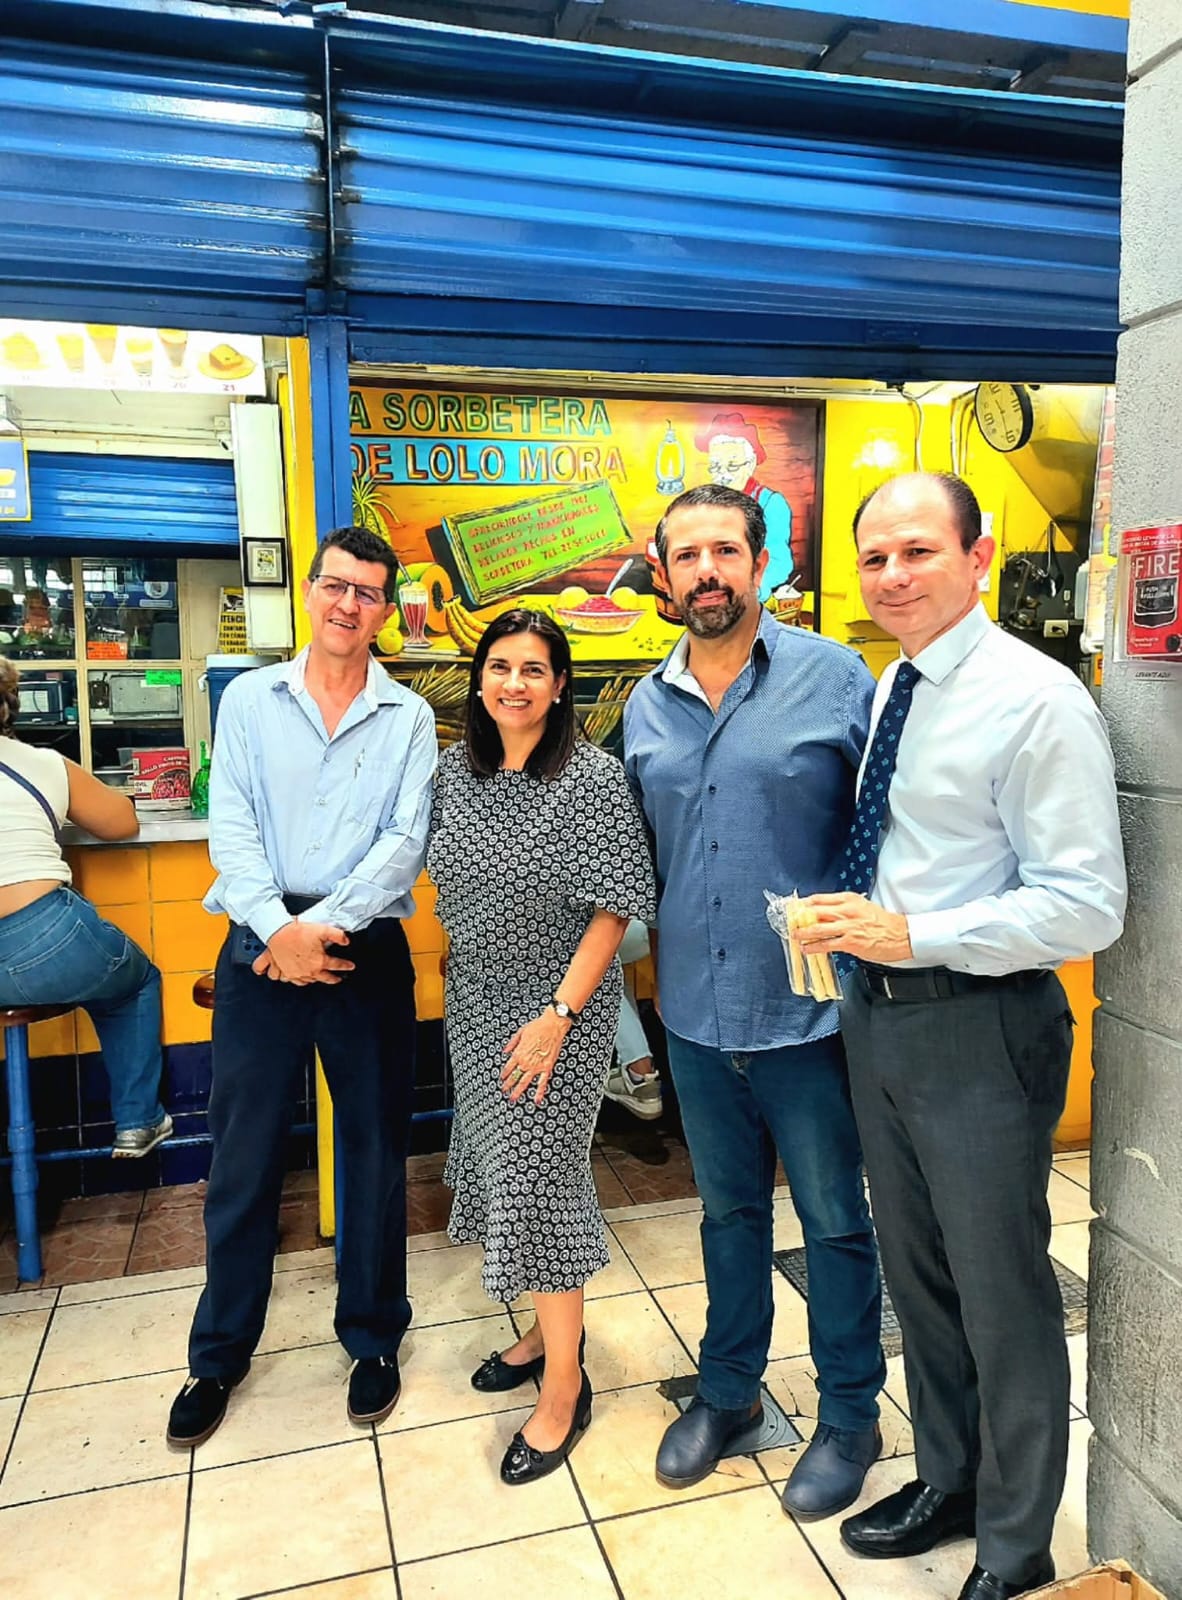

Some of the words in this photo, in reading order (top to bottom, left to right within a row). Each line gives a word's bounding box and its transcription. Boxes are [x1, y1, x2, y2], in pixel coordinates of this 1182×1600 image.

[223, 384, 235, 392] 21
[350, 391, 371, 430] A
[383, 393, 613, 436] SORBETERA
[405, 443, 505, 482] LOLO
[518, 445, 628, 484] MORA
[1135, 552, 1180, 578] FIRE
